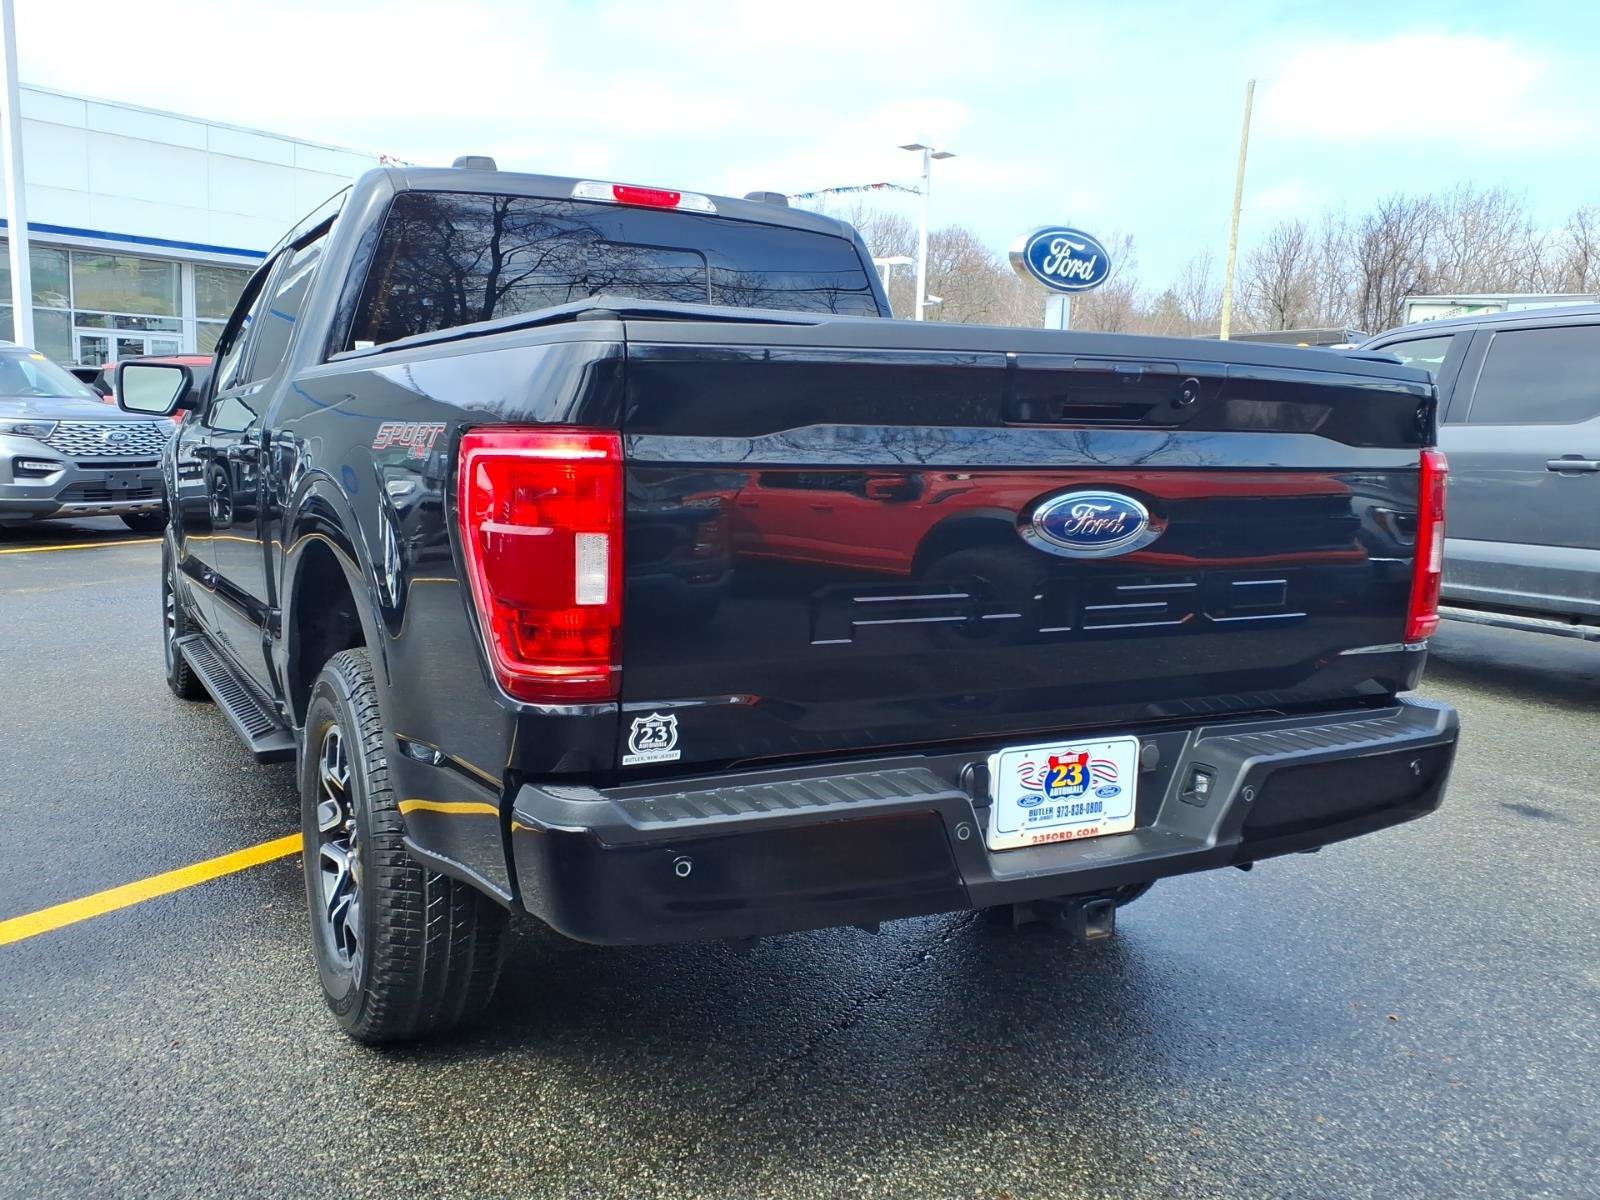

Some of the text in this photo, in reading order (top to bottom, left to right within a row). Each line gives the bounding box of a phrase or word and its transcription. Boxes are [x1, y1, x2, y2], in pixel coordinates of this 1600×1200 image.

[1043, 238, 1097, 280] Ford
[372, 422, 447, 449] SPORT
[1064, 503, 1127, 536] Ford
[640, 726, 668, 743] 23
[1051, 763, 1083, 787] 23
[1050, 785, 1083, 797] AUTOMALL
[1028, 807, 1053, 817] BUTLER
[1032, 827, 1098, 842] 23FORD.COM
